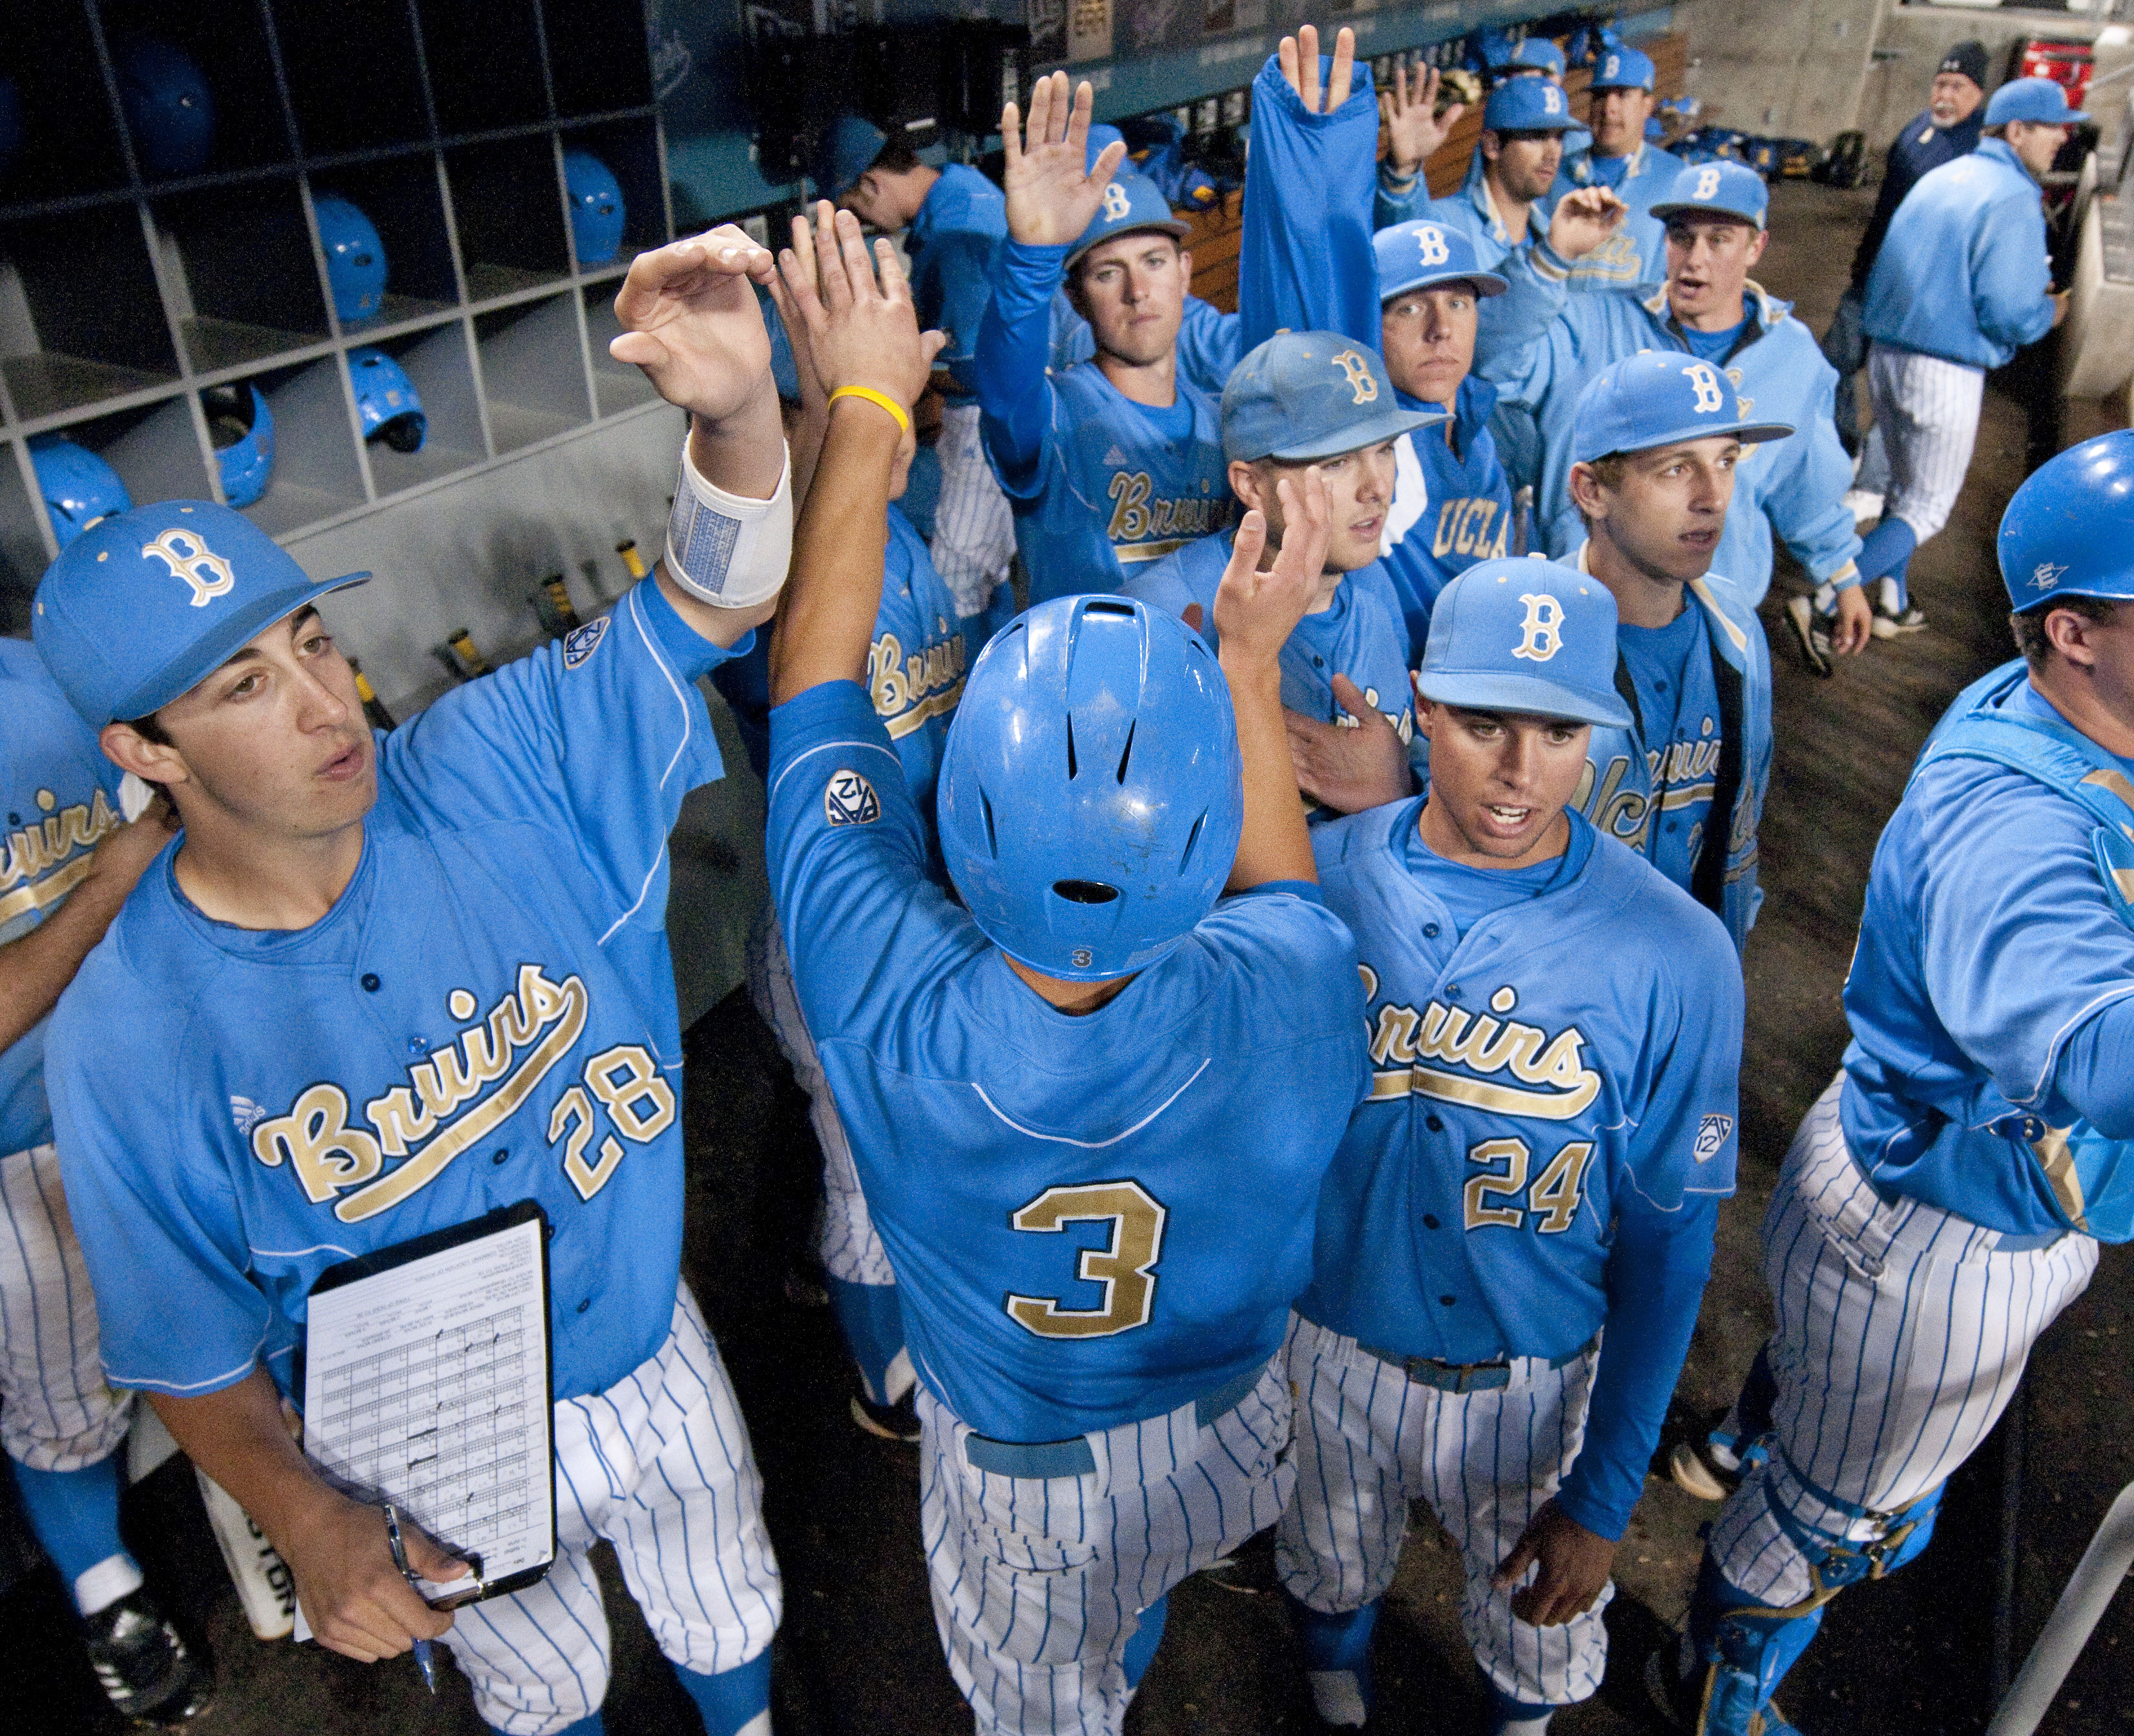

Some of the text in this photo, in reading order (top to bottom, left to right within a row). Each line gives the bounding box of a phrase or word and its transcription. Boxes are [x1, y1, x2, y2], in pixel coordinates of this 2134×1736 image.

[1603, 56, 1619, 79] B
[1542, 86, 1561, 114] B
[1103, 182, 1131, 223] B
[1692, 169, 1721, 200] B
[1411, 225, 1449, 266] B
[1332, 349, 1378, 405] B
[1682, 364, 1723, 413] B
[141, 528, 234, 607] B
[1511, 593, 1566, 662] B
[1072, 949, 1092, 967] 3
[251, 962, 583, 1209] Bruins
[548, 1044, 676, 1201] 28
[1696, 1135, 1717, 1153] 12
[1464, 1137, 1591, 1234] 24
[1008, 1181, 1165, 1338] 3
